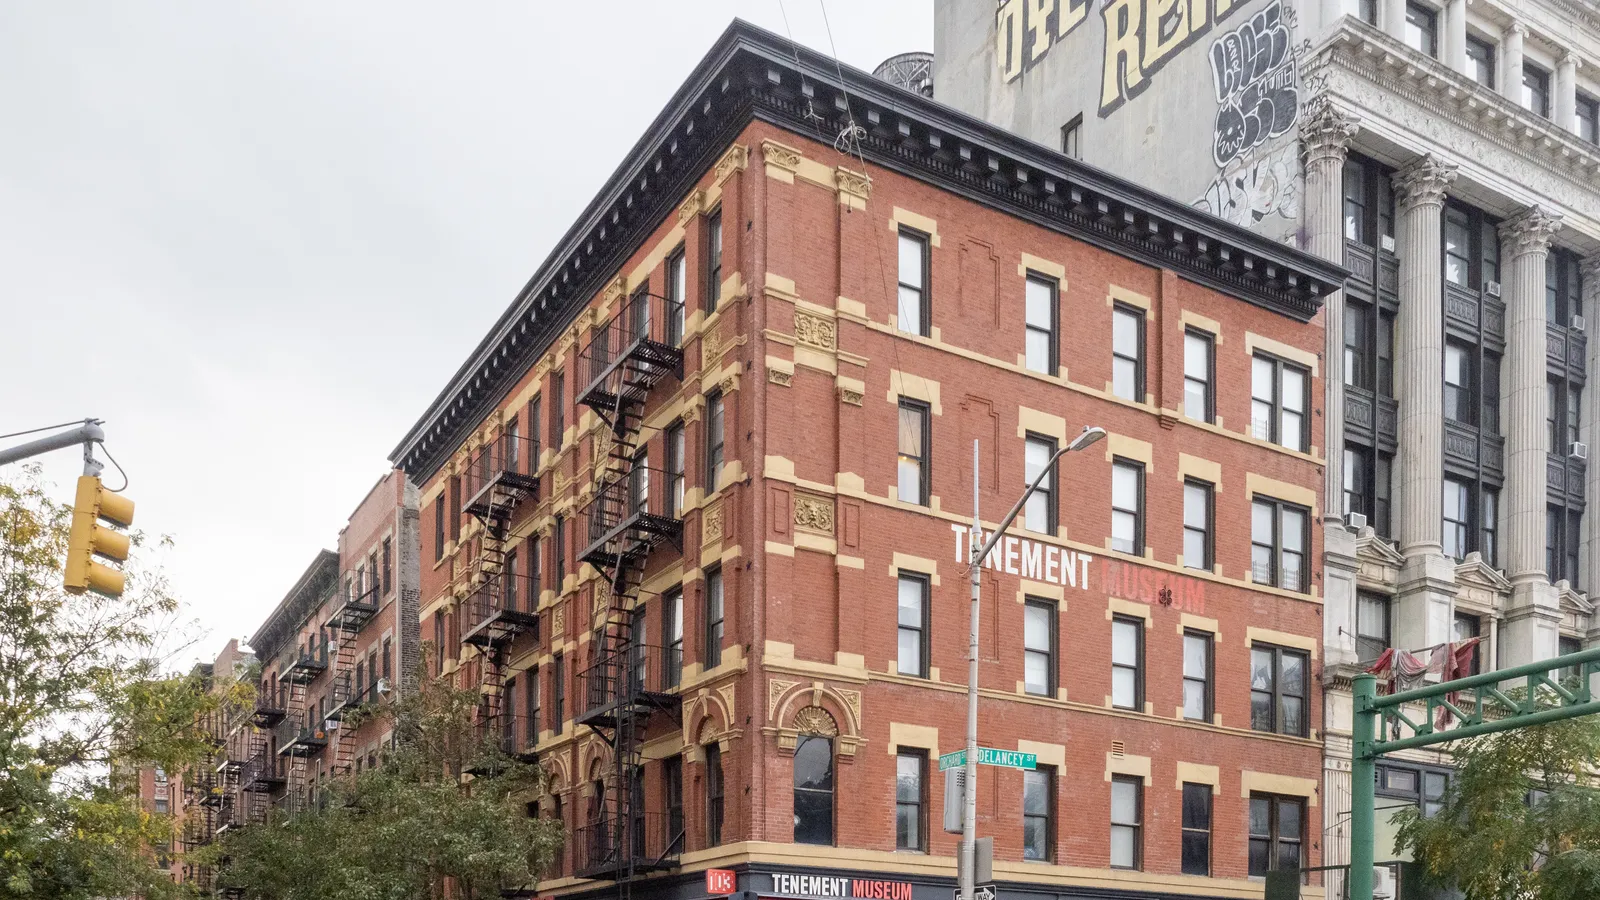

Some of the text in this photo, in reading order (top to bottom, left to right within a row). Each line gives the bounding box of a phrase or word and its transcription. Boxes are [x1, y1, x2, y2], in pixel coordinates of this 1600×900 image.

[1101, 559, 1206, 614] MUSEUM
[979, 749, 1035, 766] DELANCEY ST
[772, 873, 913, 900] TENEMENT MUSEUM
